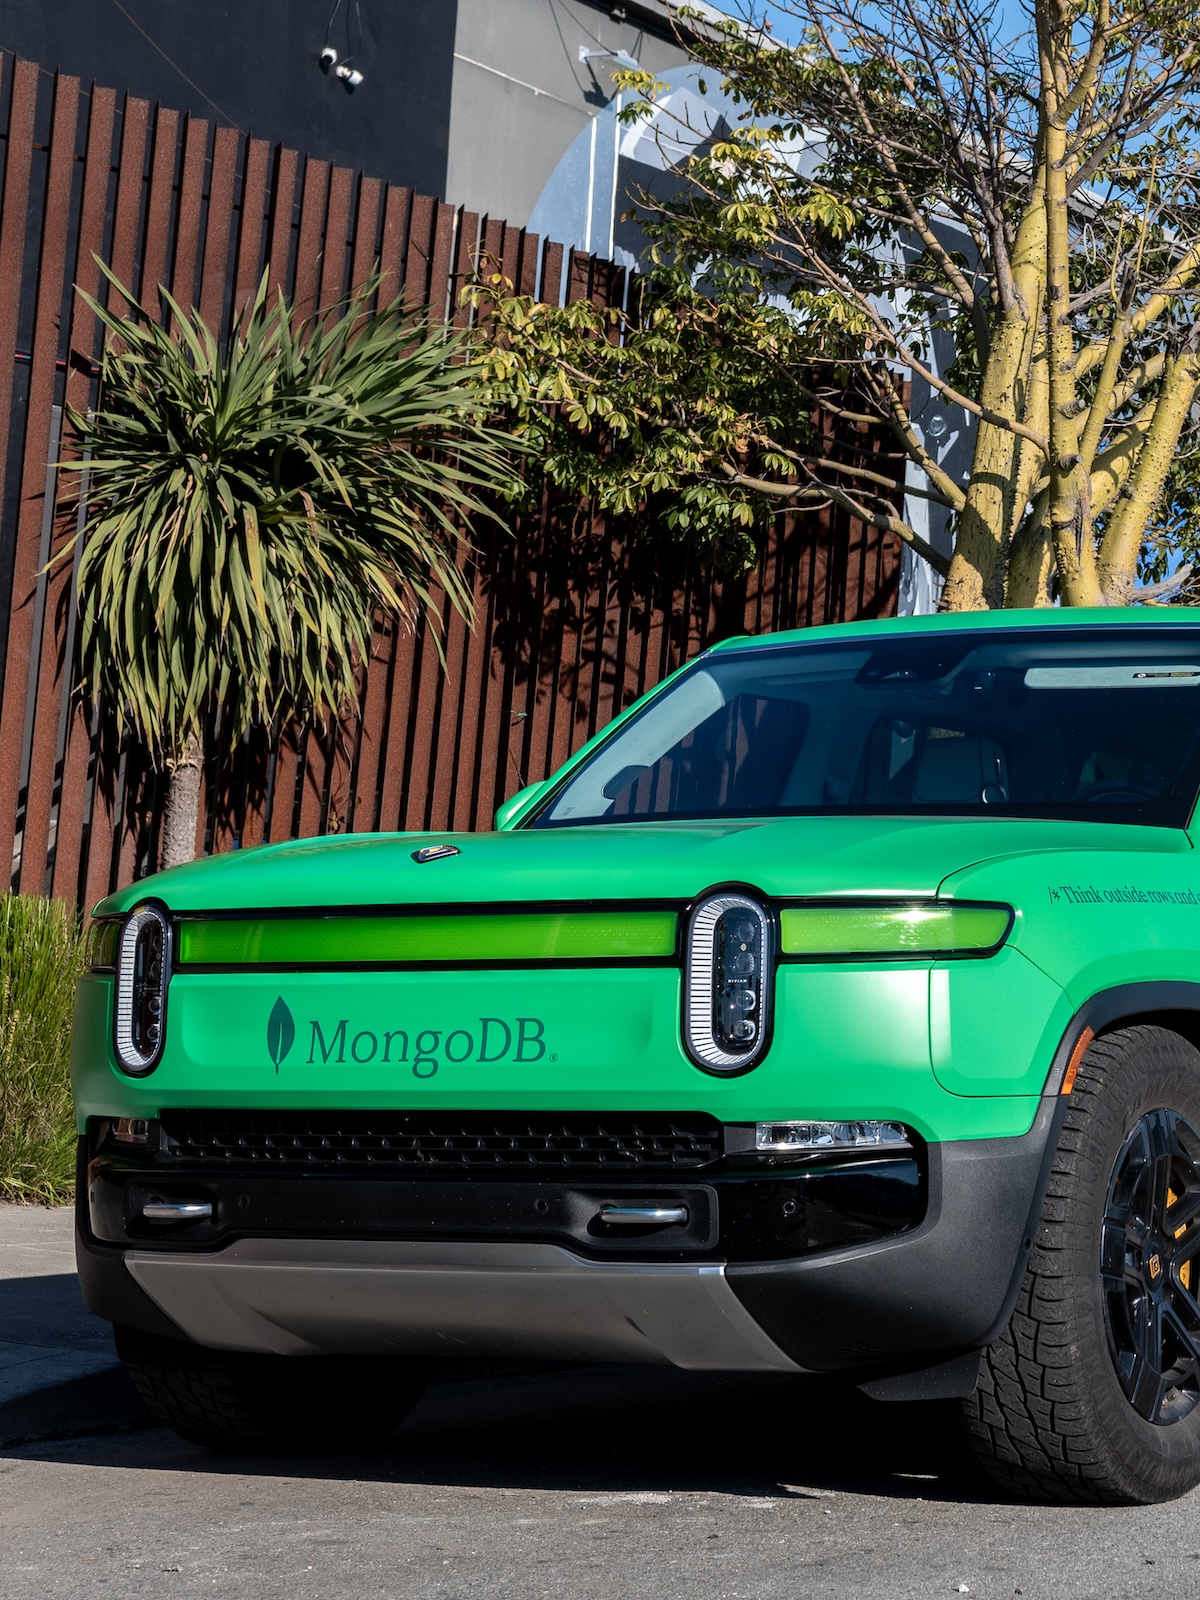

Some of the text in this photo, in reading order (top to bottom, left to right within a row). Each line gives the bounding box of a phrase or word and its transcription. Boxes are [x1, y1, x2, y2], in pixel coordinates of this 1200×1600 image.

[1060, 886, 1103, 904] Think
[1103, 886, 1148, 903] outside
[1148, 891, 1176, 904] rows
[1175, 889, 1199, 905] and
